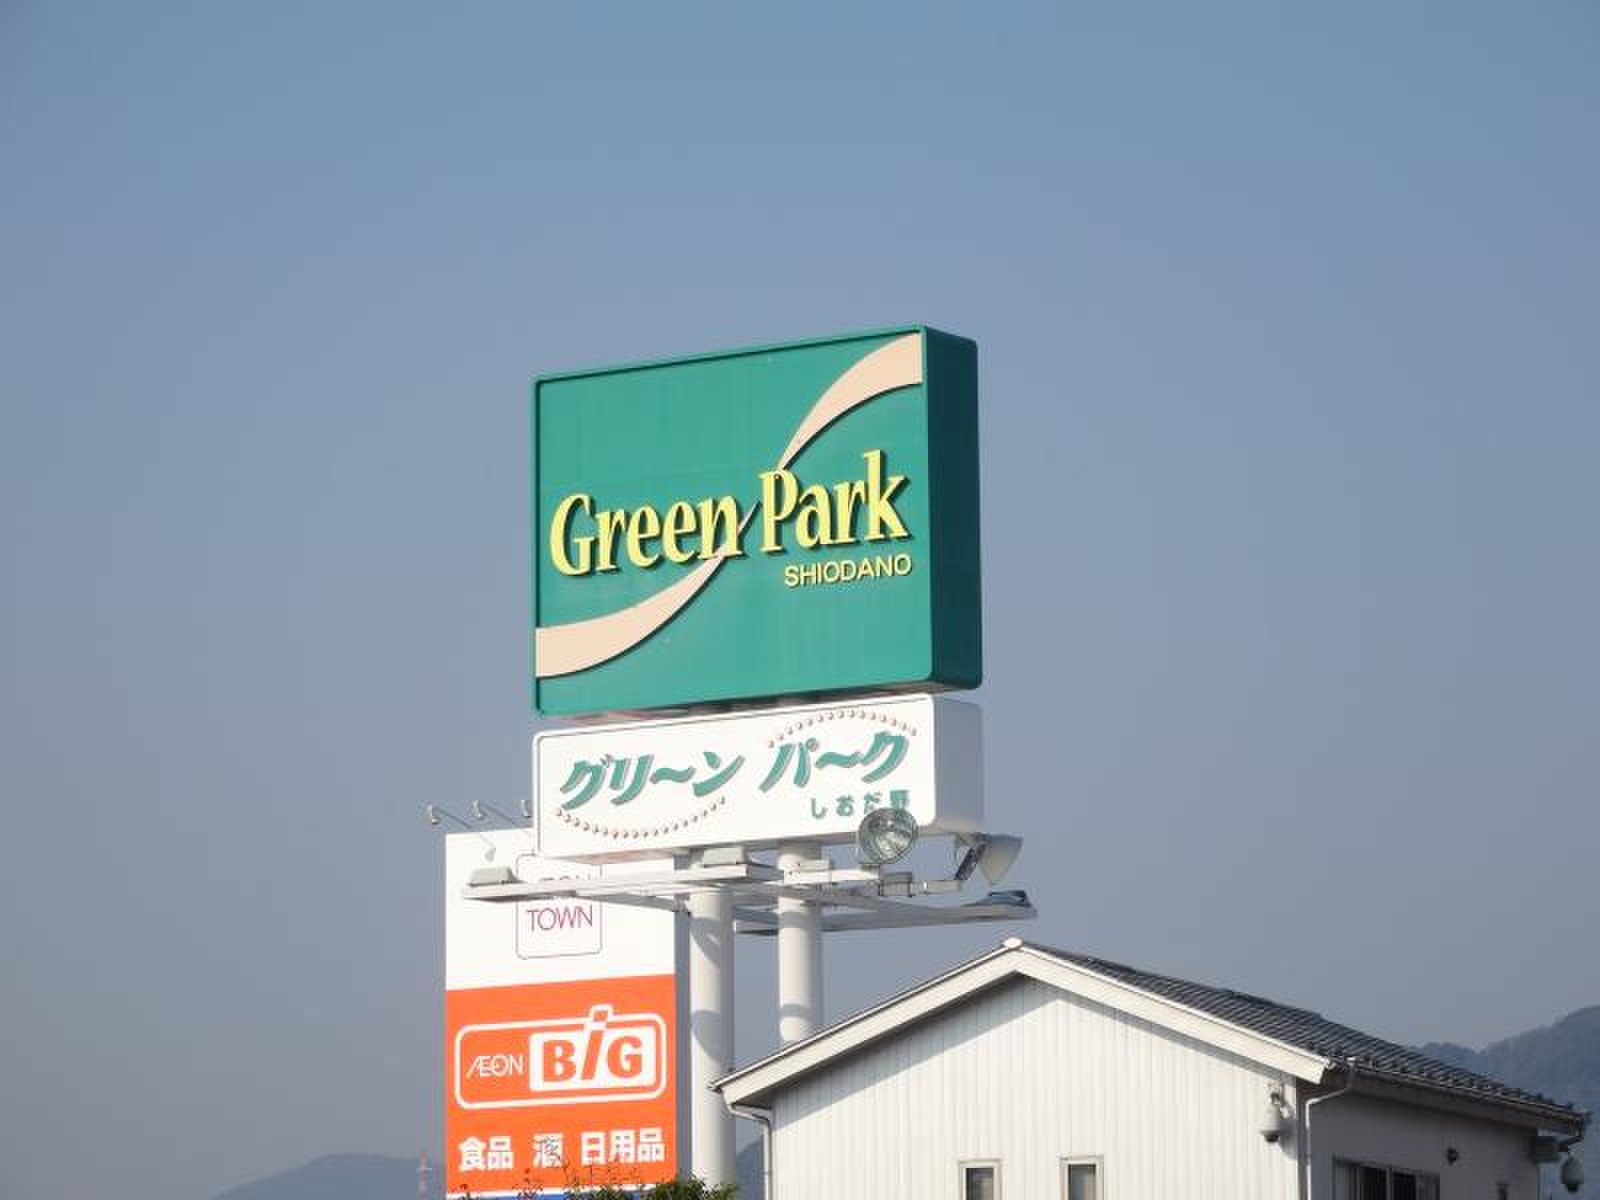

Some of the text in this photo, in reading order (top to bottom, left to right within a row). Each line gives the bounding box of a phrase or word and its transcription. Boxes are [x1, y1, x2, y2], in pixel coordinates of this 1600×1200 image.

[549, 449, 910, 577] Green Park
[784, 554, 912, 588] SHIODANO
[525, 904, 594, 931] TOWN
[457, 1135, 514, 1172] 食品
[580, 1127, 666, 1166] 日用品
